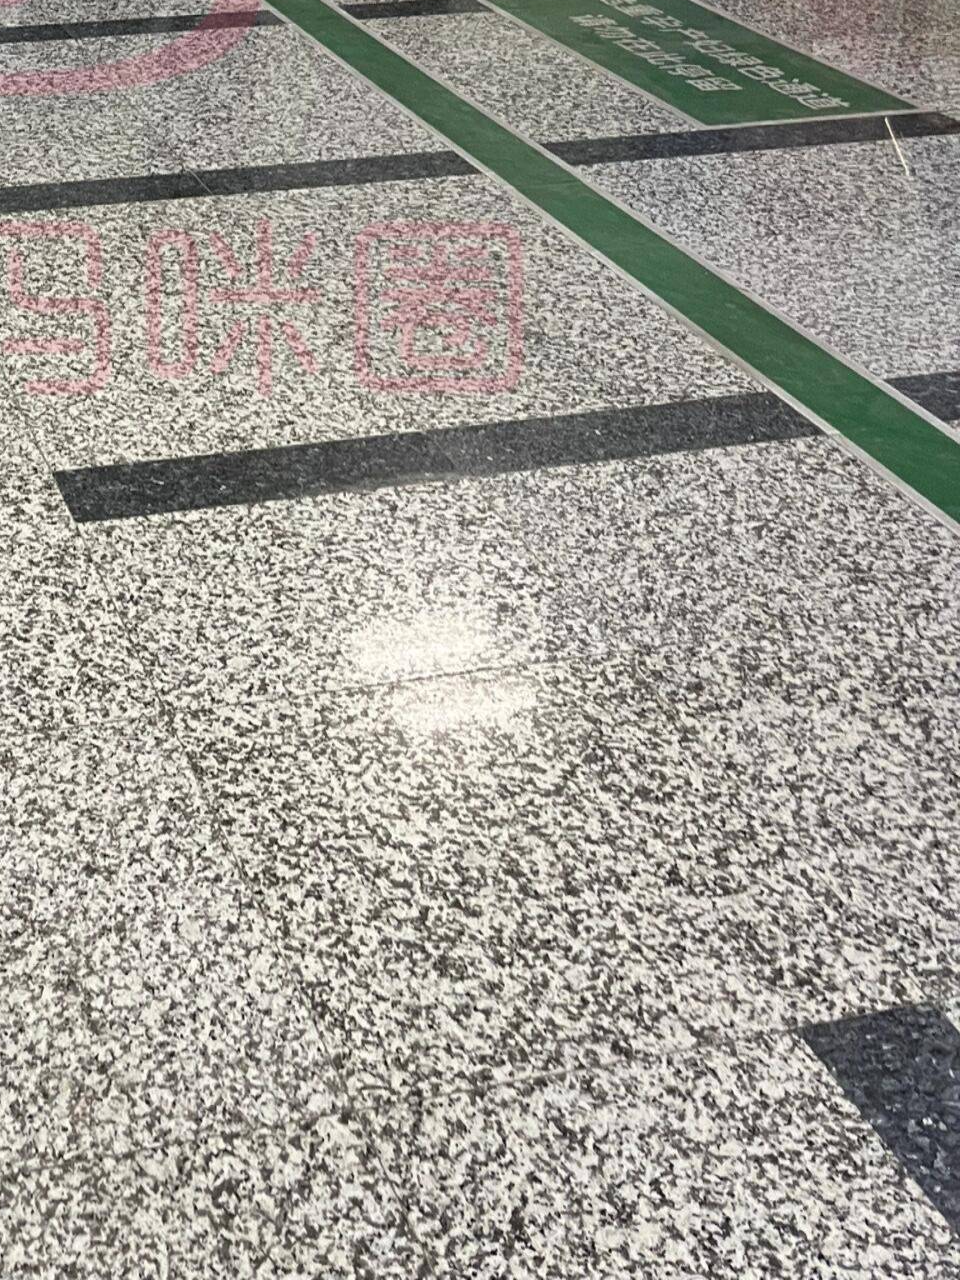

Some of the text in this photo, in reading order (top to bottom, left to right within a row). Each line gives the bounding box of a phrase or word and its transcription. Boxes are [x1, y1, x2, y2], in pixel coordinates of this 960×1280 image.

[569, 14, 743, 92] 请勿在此停留
